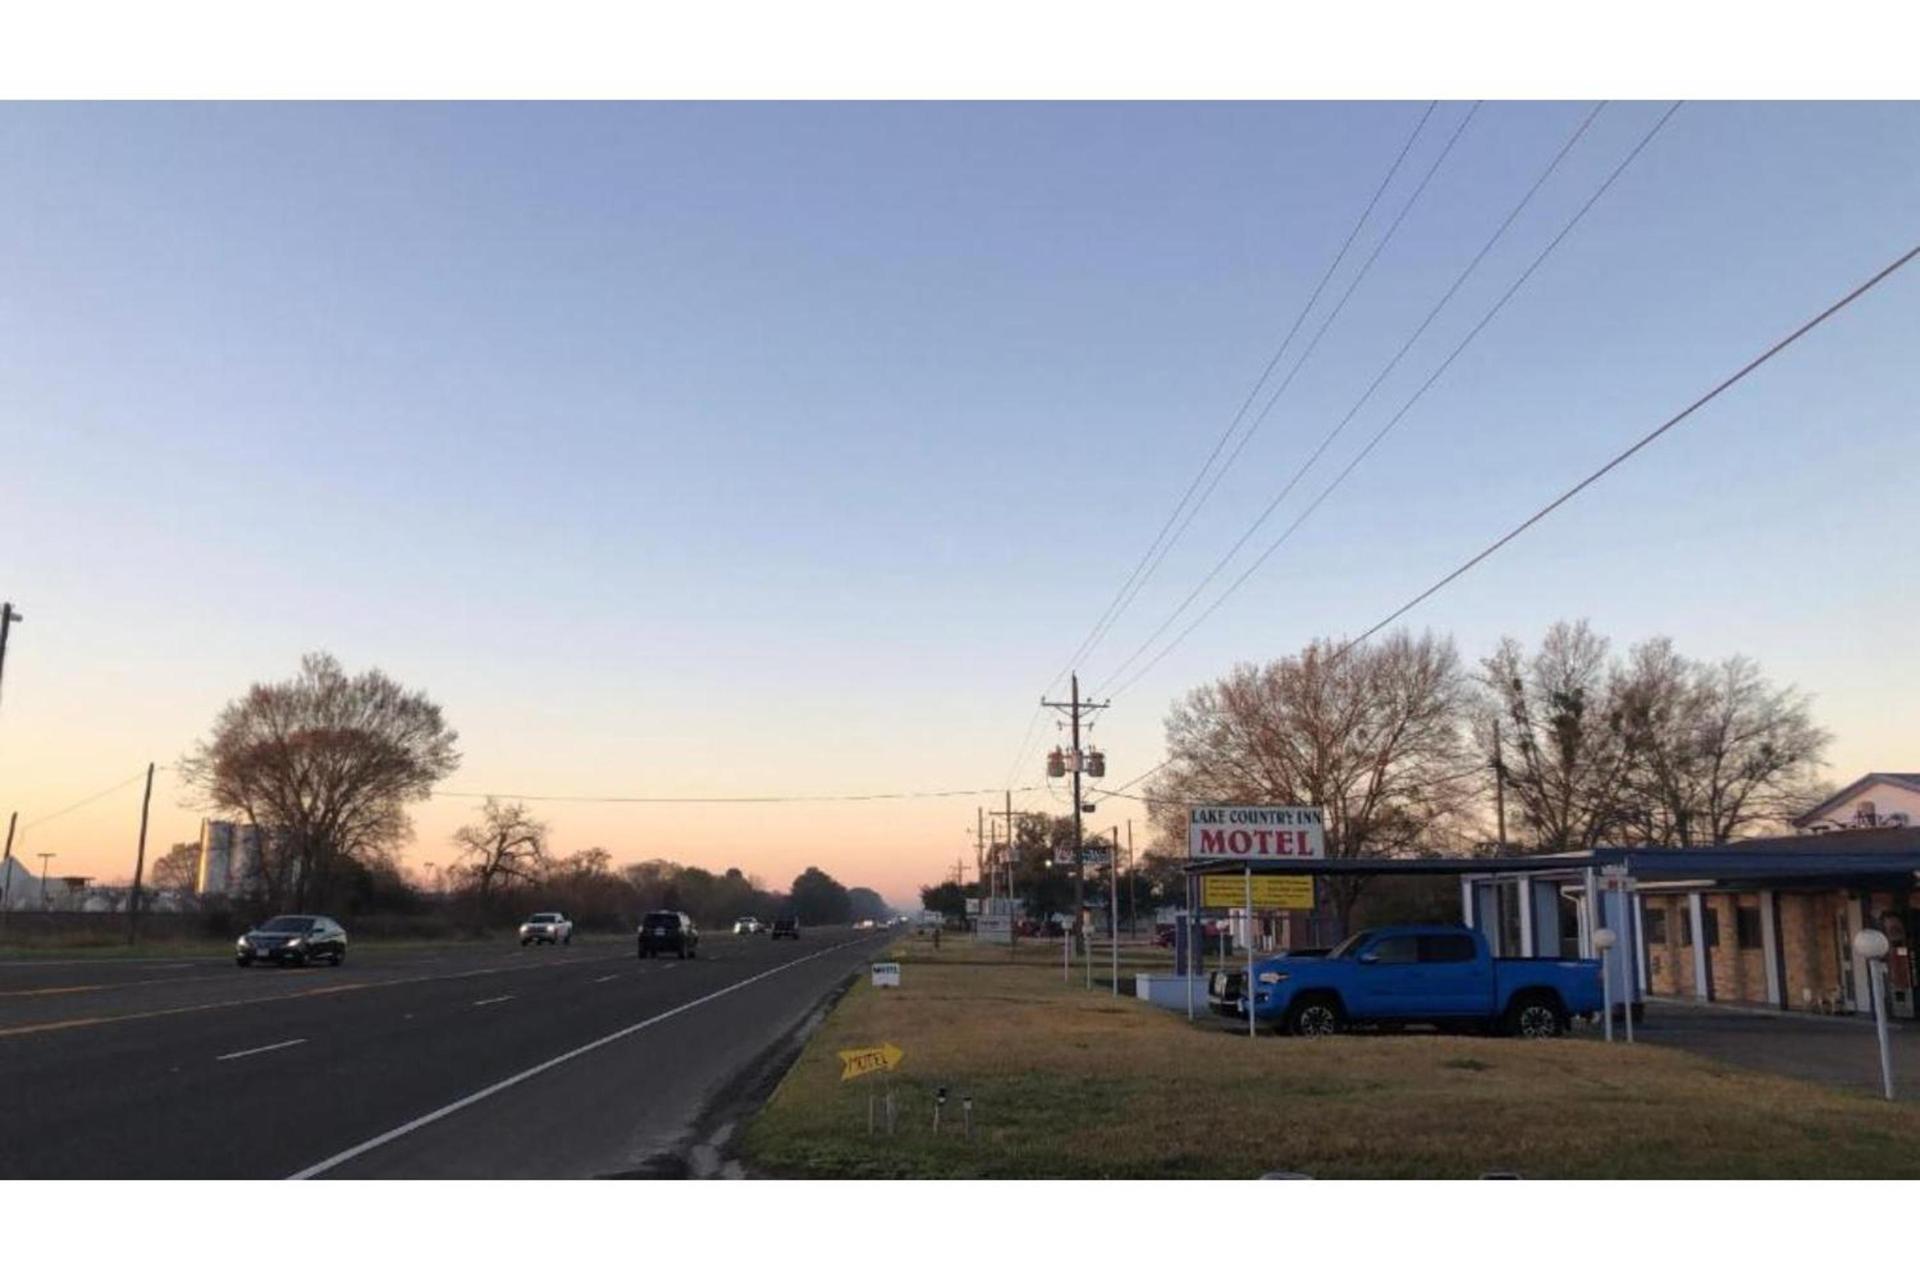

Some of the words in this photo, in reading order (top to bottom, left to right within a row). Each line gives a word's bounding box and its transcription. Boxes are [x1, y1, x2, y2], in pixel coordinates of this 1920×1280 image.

[1192, 809, 1225, 824] LAKE
[1230, 810, 1294, 825] COUNTRY
[1297, 811, 1321, 825] INN
[1200, 829, 1314, 856] MOTEL
